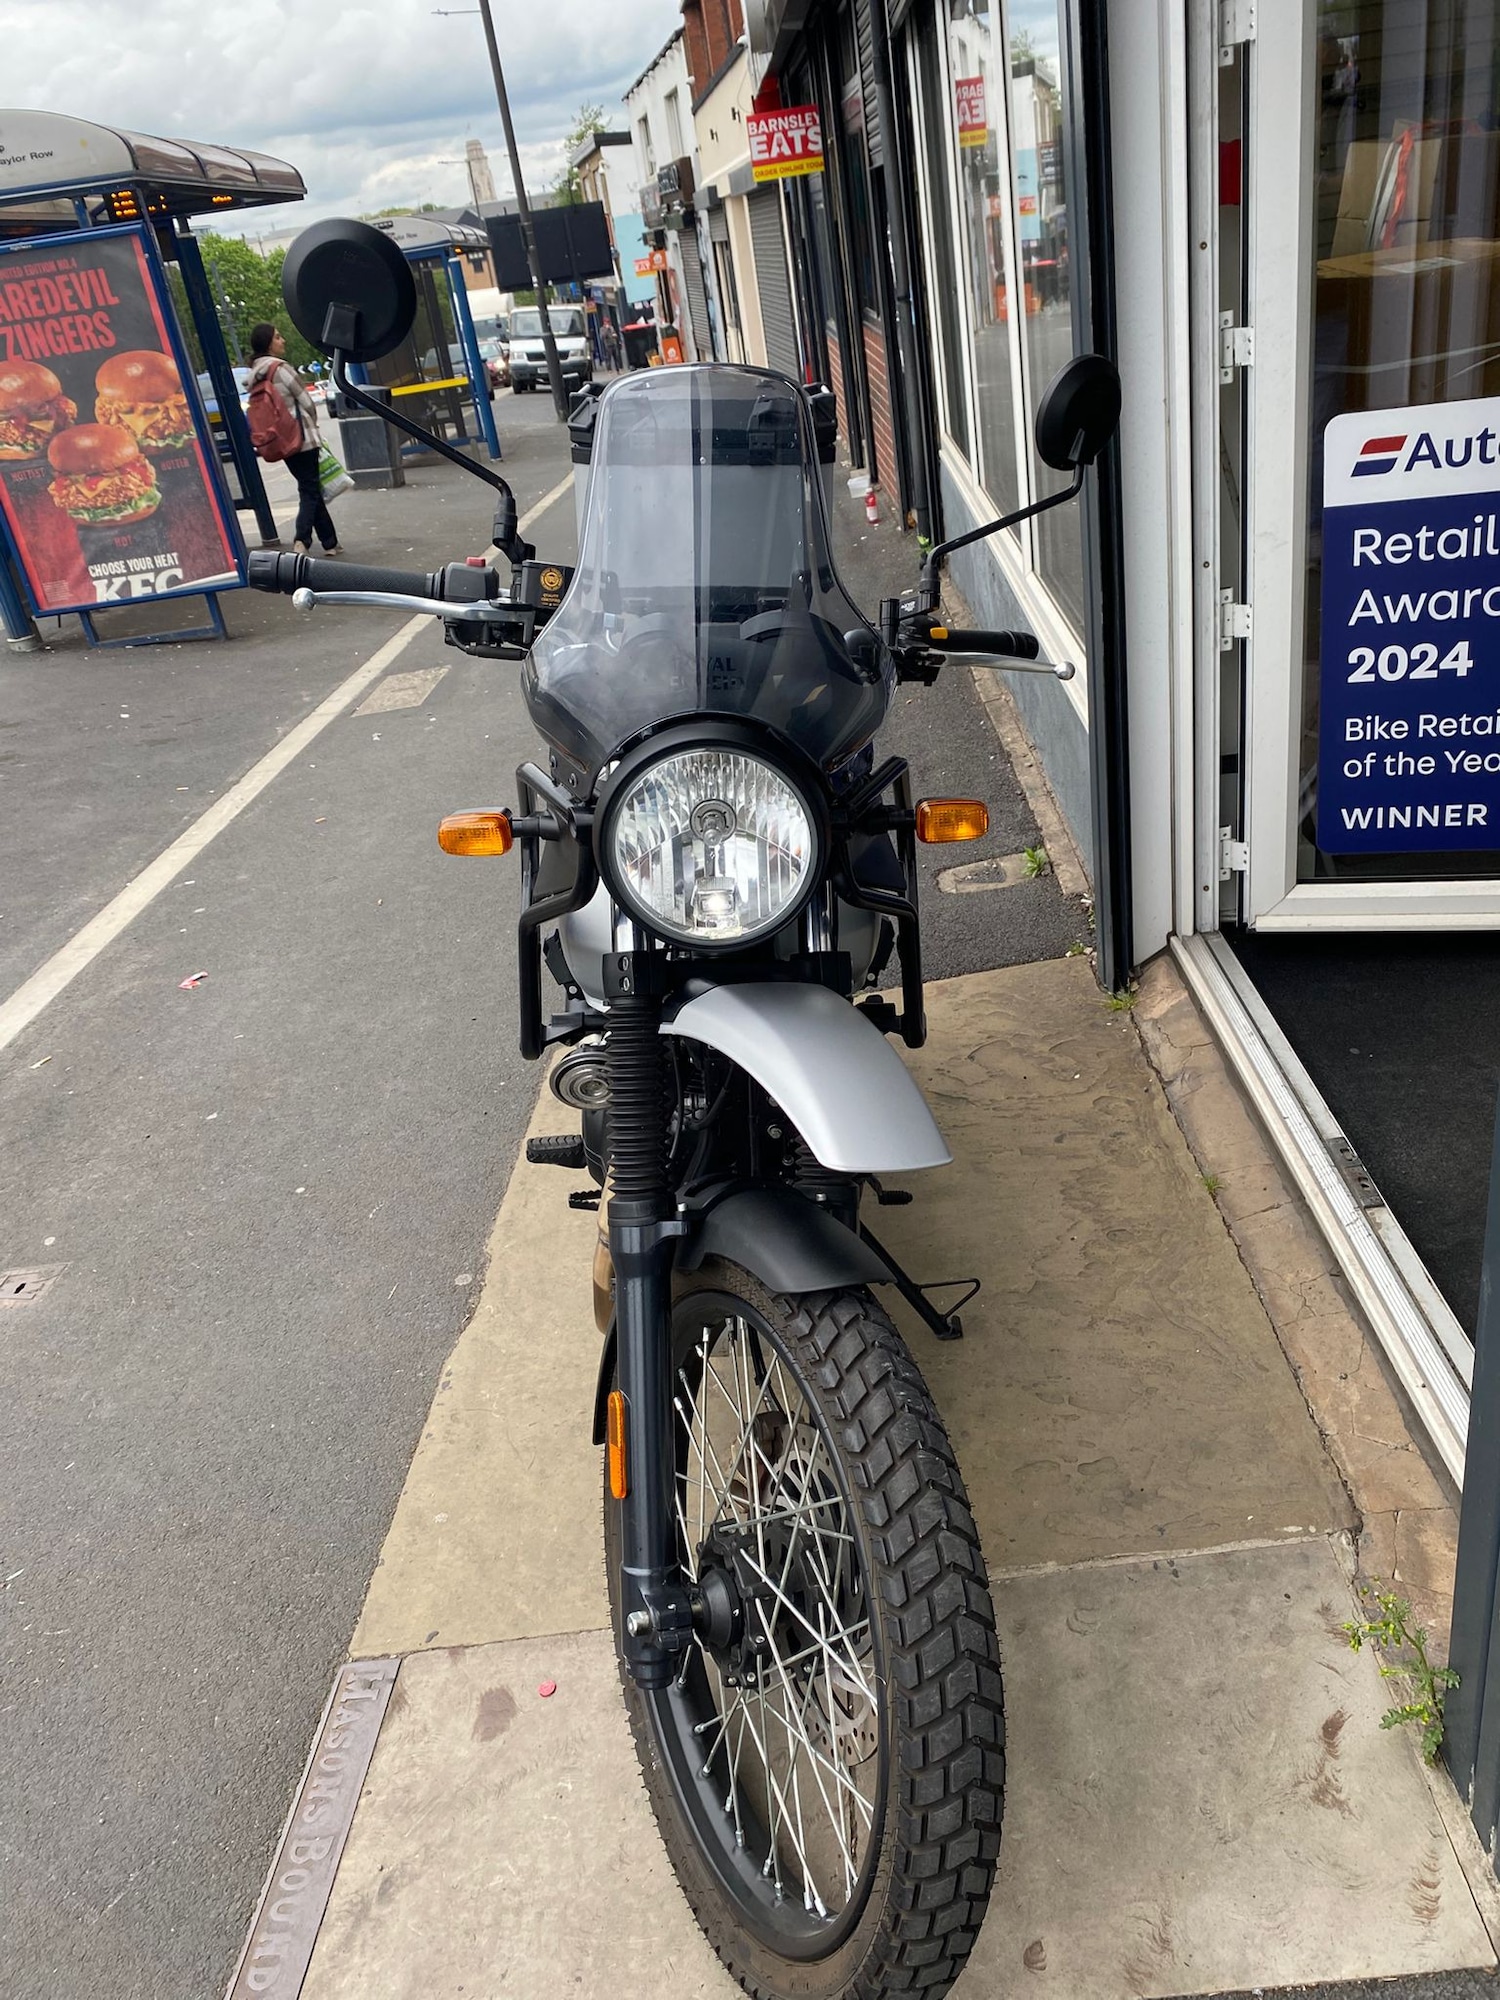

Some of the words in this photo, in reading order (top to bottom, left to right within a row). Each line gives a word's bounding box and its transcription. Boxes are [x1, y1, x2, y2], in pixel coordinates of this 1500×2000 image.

[748, 111, 819, 135] BARNSLEY
[30, 150, 53, 160] Row
[750, 126, 822, 161] EATS
[0, 310, 116, 360] ZINGERS
[1404, 427, 1500, 472] Aut
[113, 535, 133, 547] HOT
[1353, 514, 1499, 567] Retail
[88, 561, 127, 577] CHOOSE
[126, 556, 155, 572] YOUR
[153, 552, 179, 568] HEAT
[92, 568, 184, 603] KFC
[1347, 641, 1474, 683] 2024
[1345, 714, 1409, 741] Bike
[1343, 752, 1377, 778] of
[1384, 751, 1436, 776] the
[1341, 803, 1488, 829] WINNER
[303, 1670, 385, 1824] MASONS
[246, 1836, 334, 2000] BOUND
